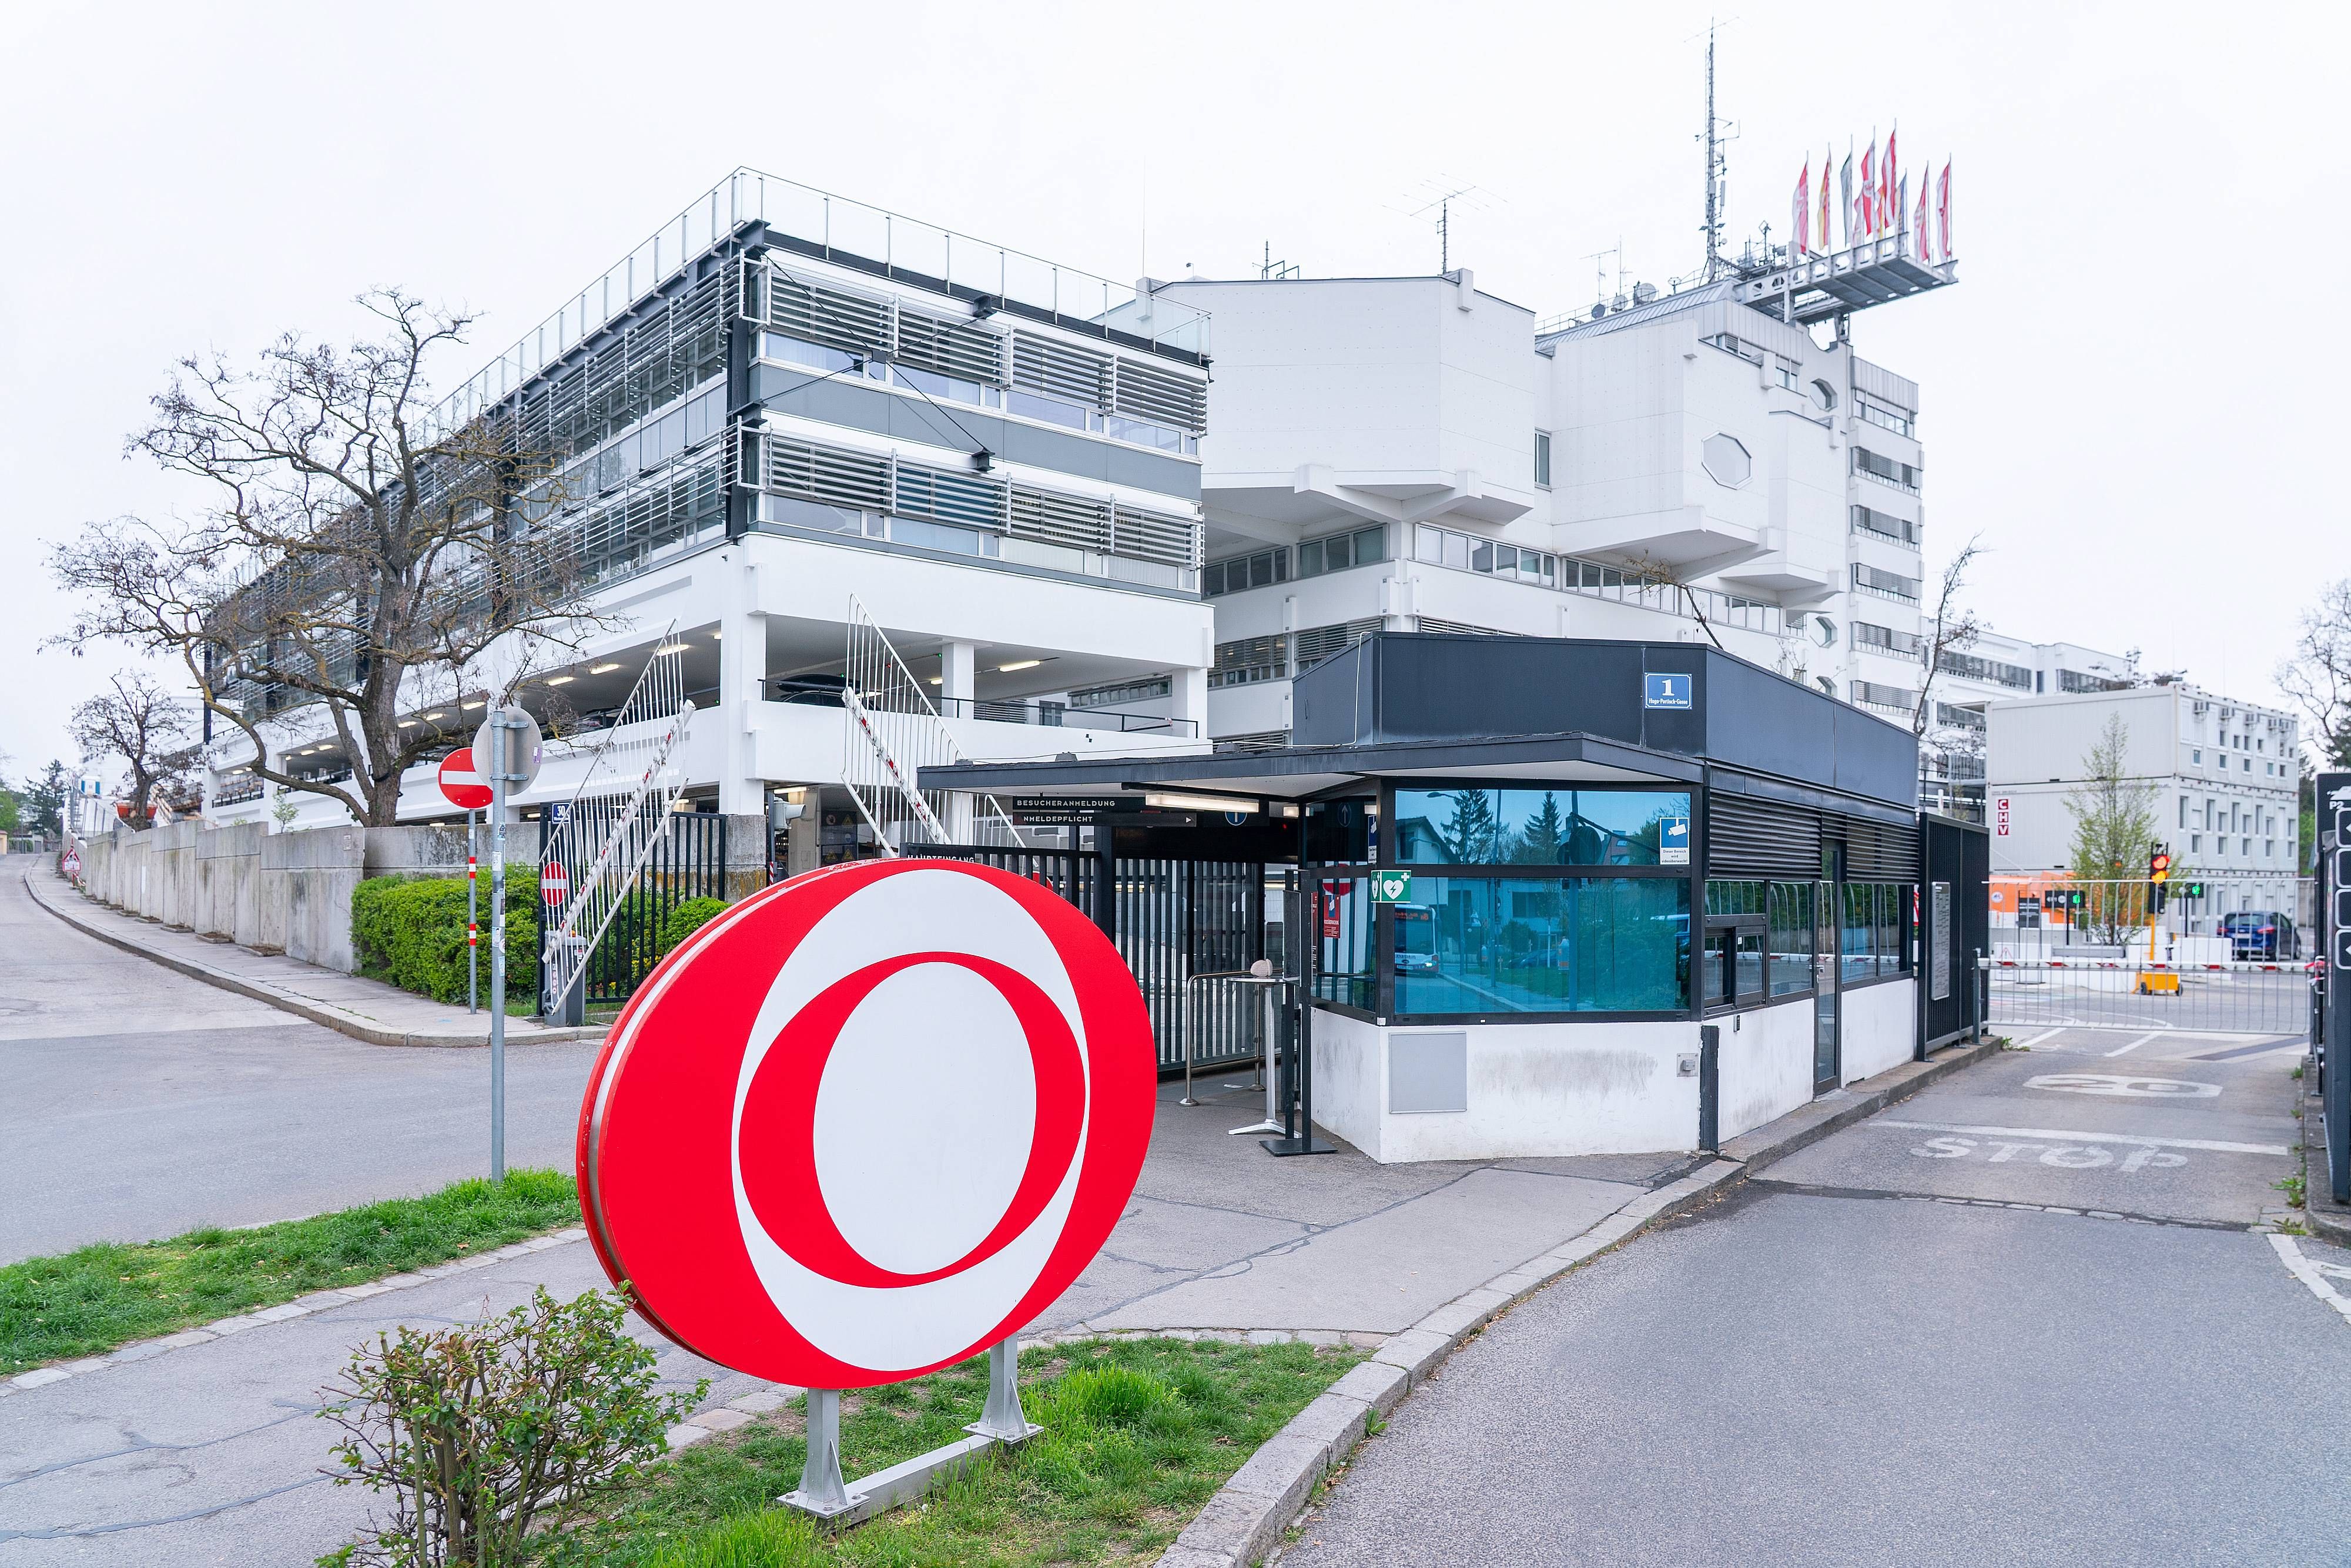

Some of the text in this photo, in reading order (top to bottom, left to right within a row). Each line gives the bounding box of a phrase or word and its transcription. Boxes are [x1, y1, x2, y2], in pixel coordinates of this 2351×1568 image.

[1662, 679, 1674, 696] 1
[557, 805, 565, 816] 30
[1998, 799, 2008, 835] CHV
[1910, 1137, 2188, 1172] STOP
